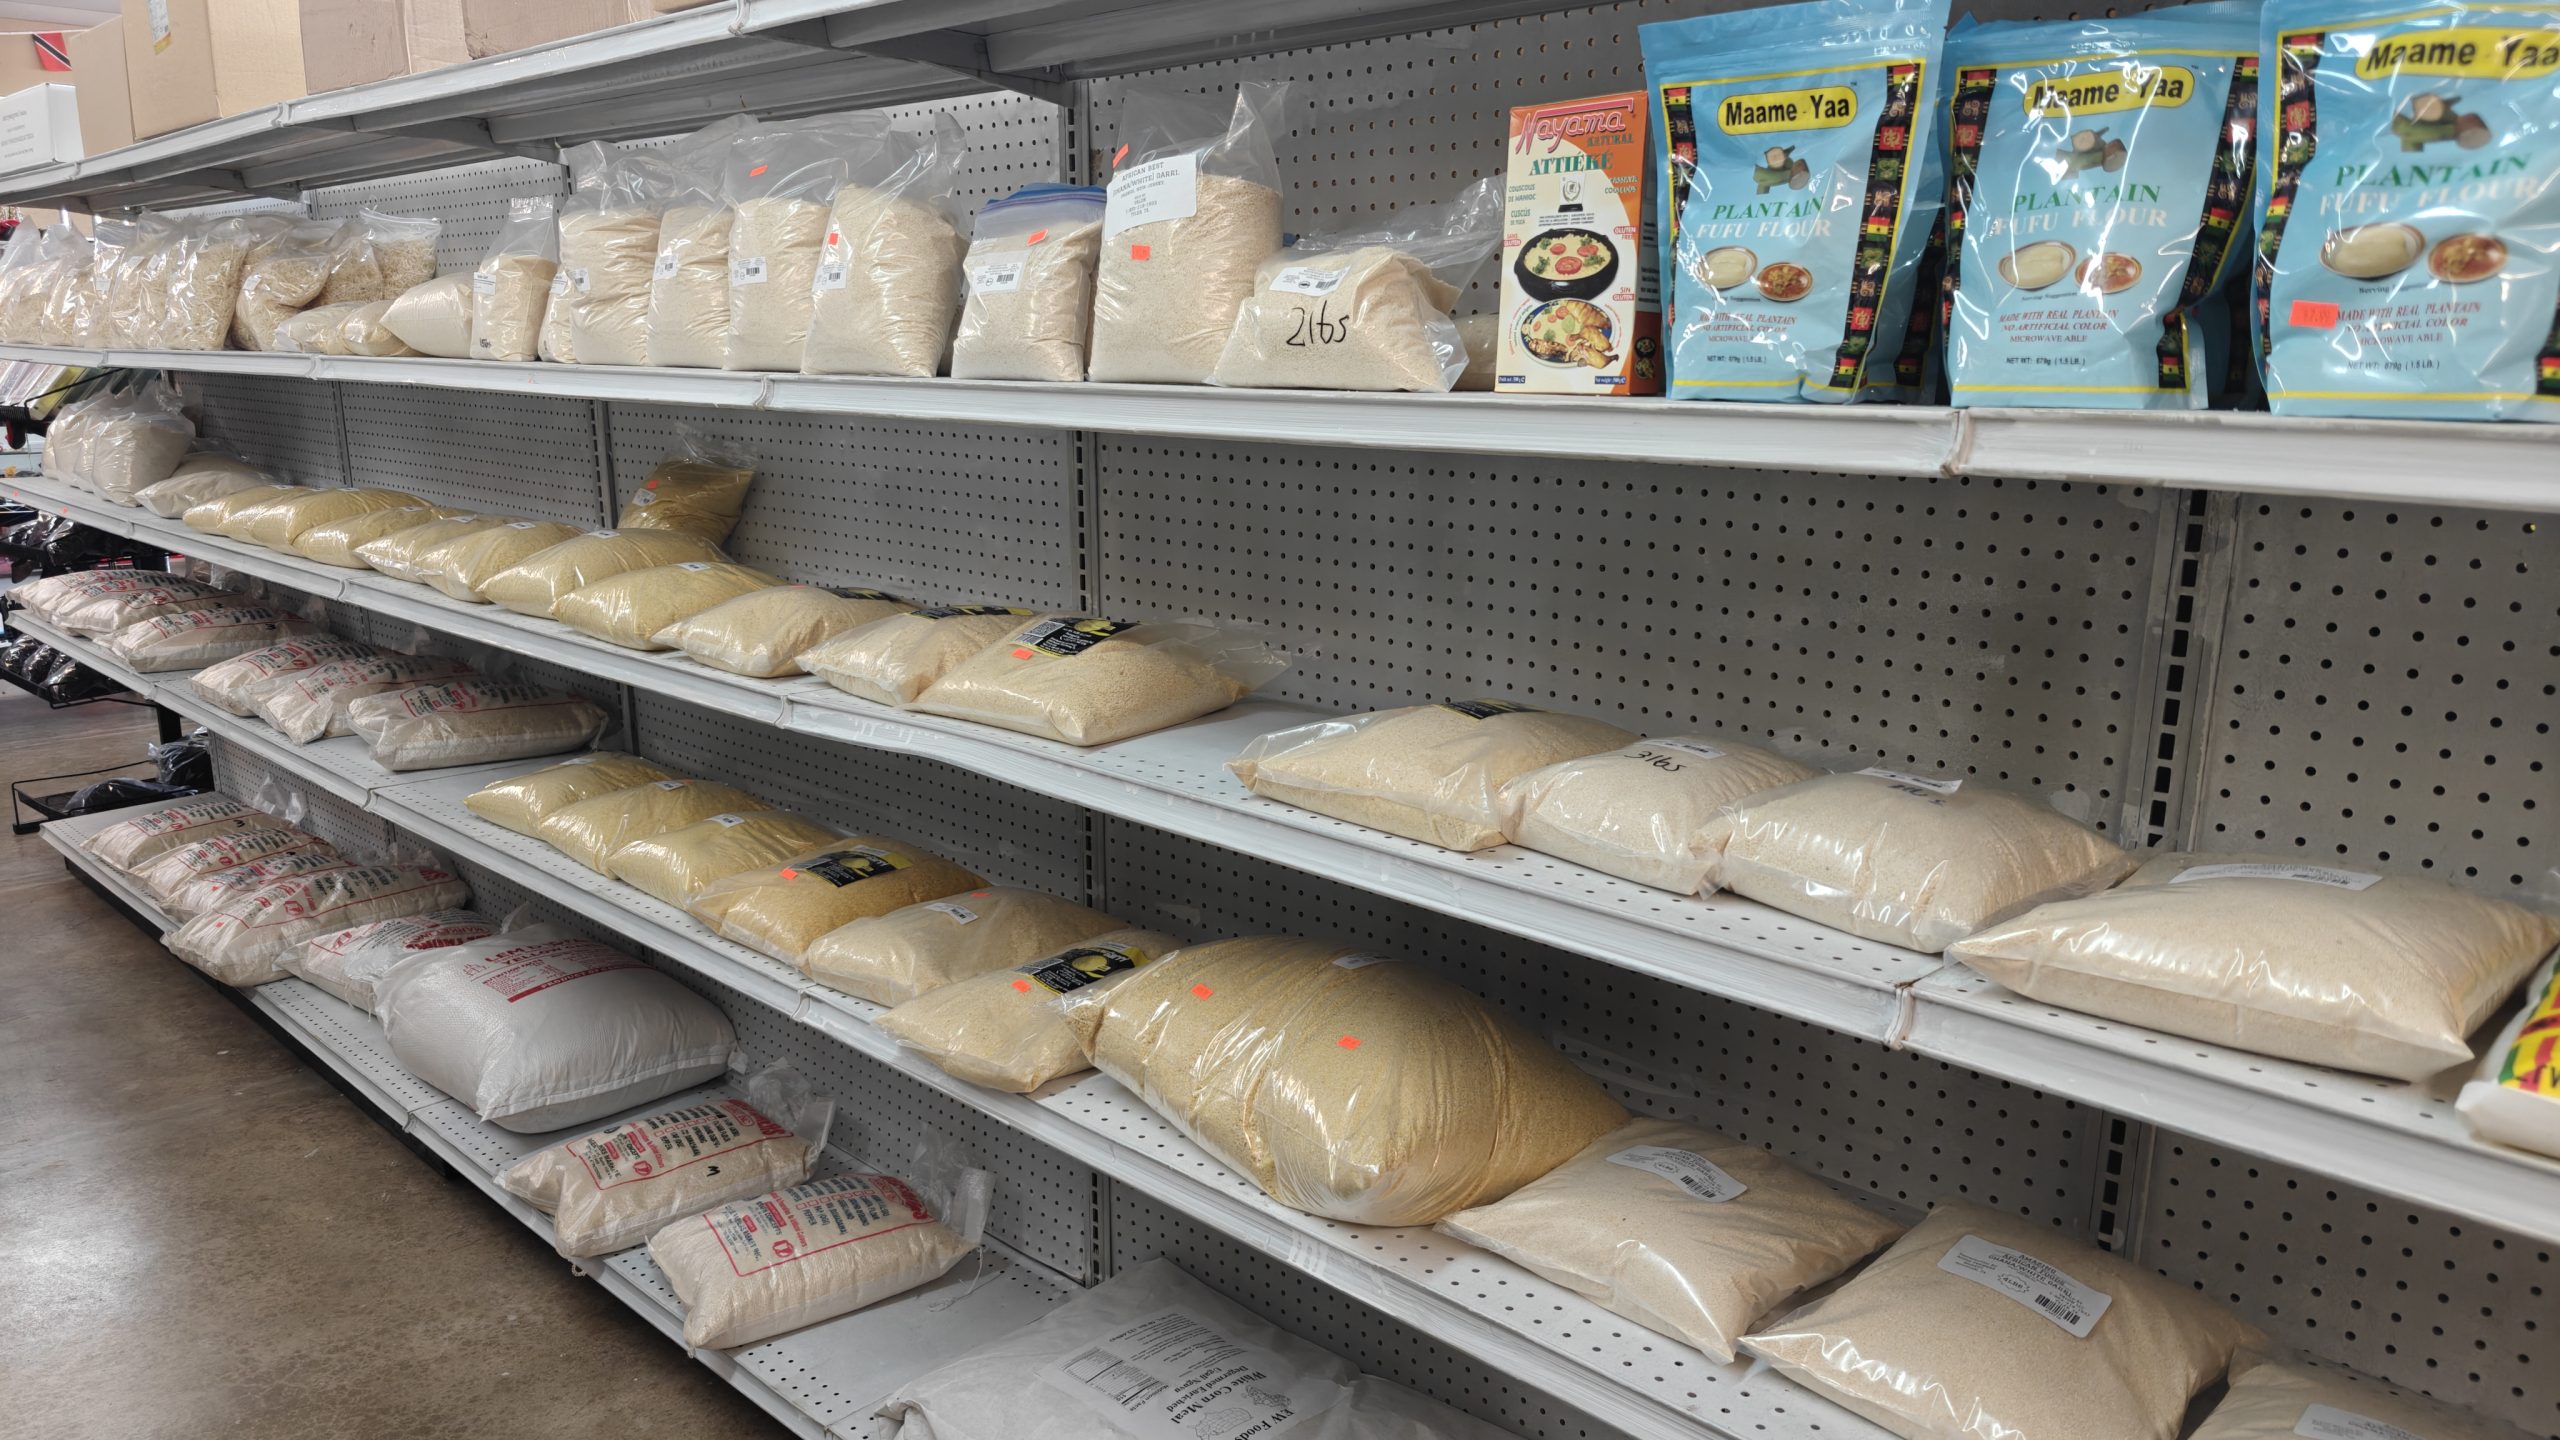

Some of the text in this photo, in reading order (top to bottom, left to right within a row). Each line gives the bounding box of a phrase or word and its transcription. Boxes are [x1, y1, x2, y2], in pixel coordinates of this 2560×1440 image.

[2366, 43, 2476, 72] Maame
[2033, 71, 2184, 110] Maame Yaa
[1726, 95, 1850, 126] Maame Yaa
[1515, 98, 1634, 155] Nayama
[1147, 161, 1165, 172] BEST
[1528, 149, 1615, 176] ATTIÉKÉ
[2336, 152, 2534, 187] PLANTAIN
[1712, 197, 1824, 220] PLANTAIN
[2009, 184, 2161, 214] PLANTAIN
[2320, 191, 2400, 216] FUFU
[1697, 219, 1832, 239] FUFU FLOUR
[1994, 206, 2167, 236] FUFU FLOUR
[1756, 313, 1797, 326] PLANTAIN
[2046, 309, 2069, 320] REAL
[2336, 302, 2482, 321] MADE WITH REAL PLANTAIN
[2009, 335, 2063, 343] MICROWAVE
[2017, 322, 2070, 332] ARTIFICIAL
[2072, 322, 2109, 331] COLOR
[2416, 333, 2443, 343] ABLE
[1165, 1364, 1249, 1413] Degermed Enriched
[1170, 1369, 1268, 1425] White Corn Meal
[1234, 1407, 1296, 1440] EW Foods
